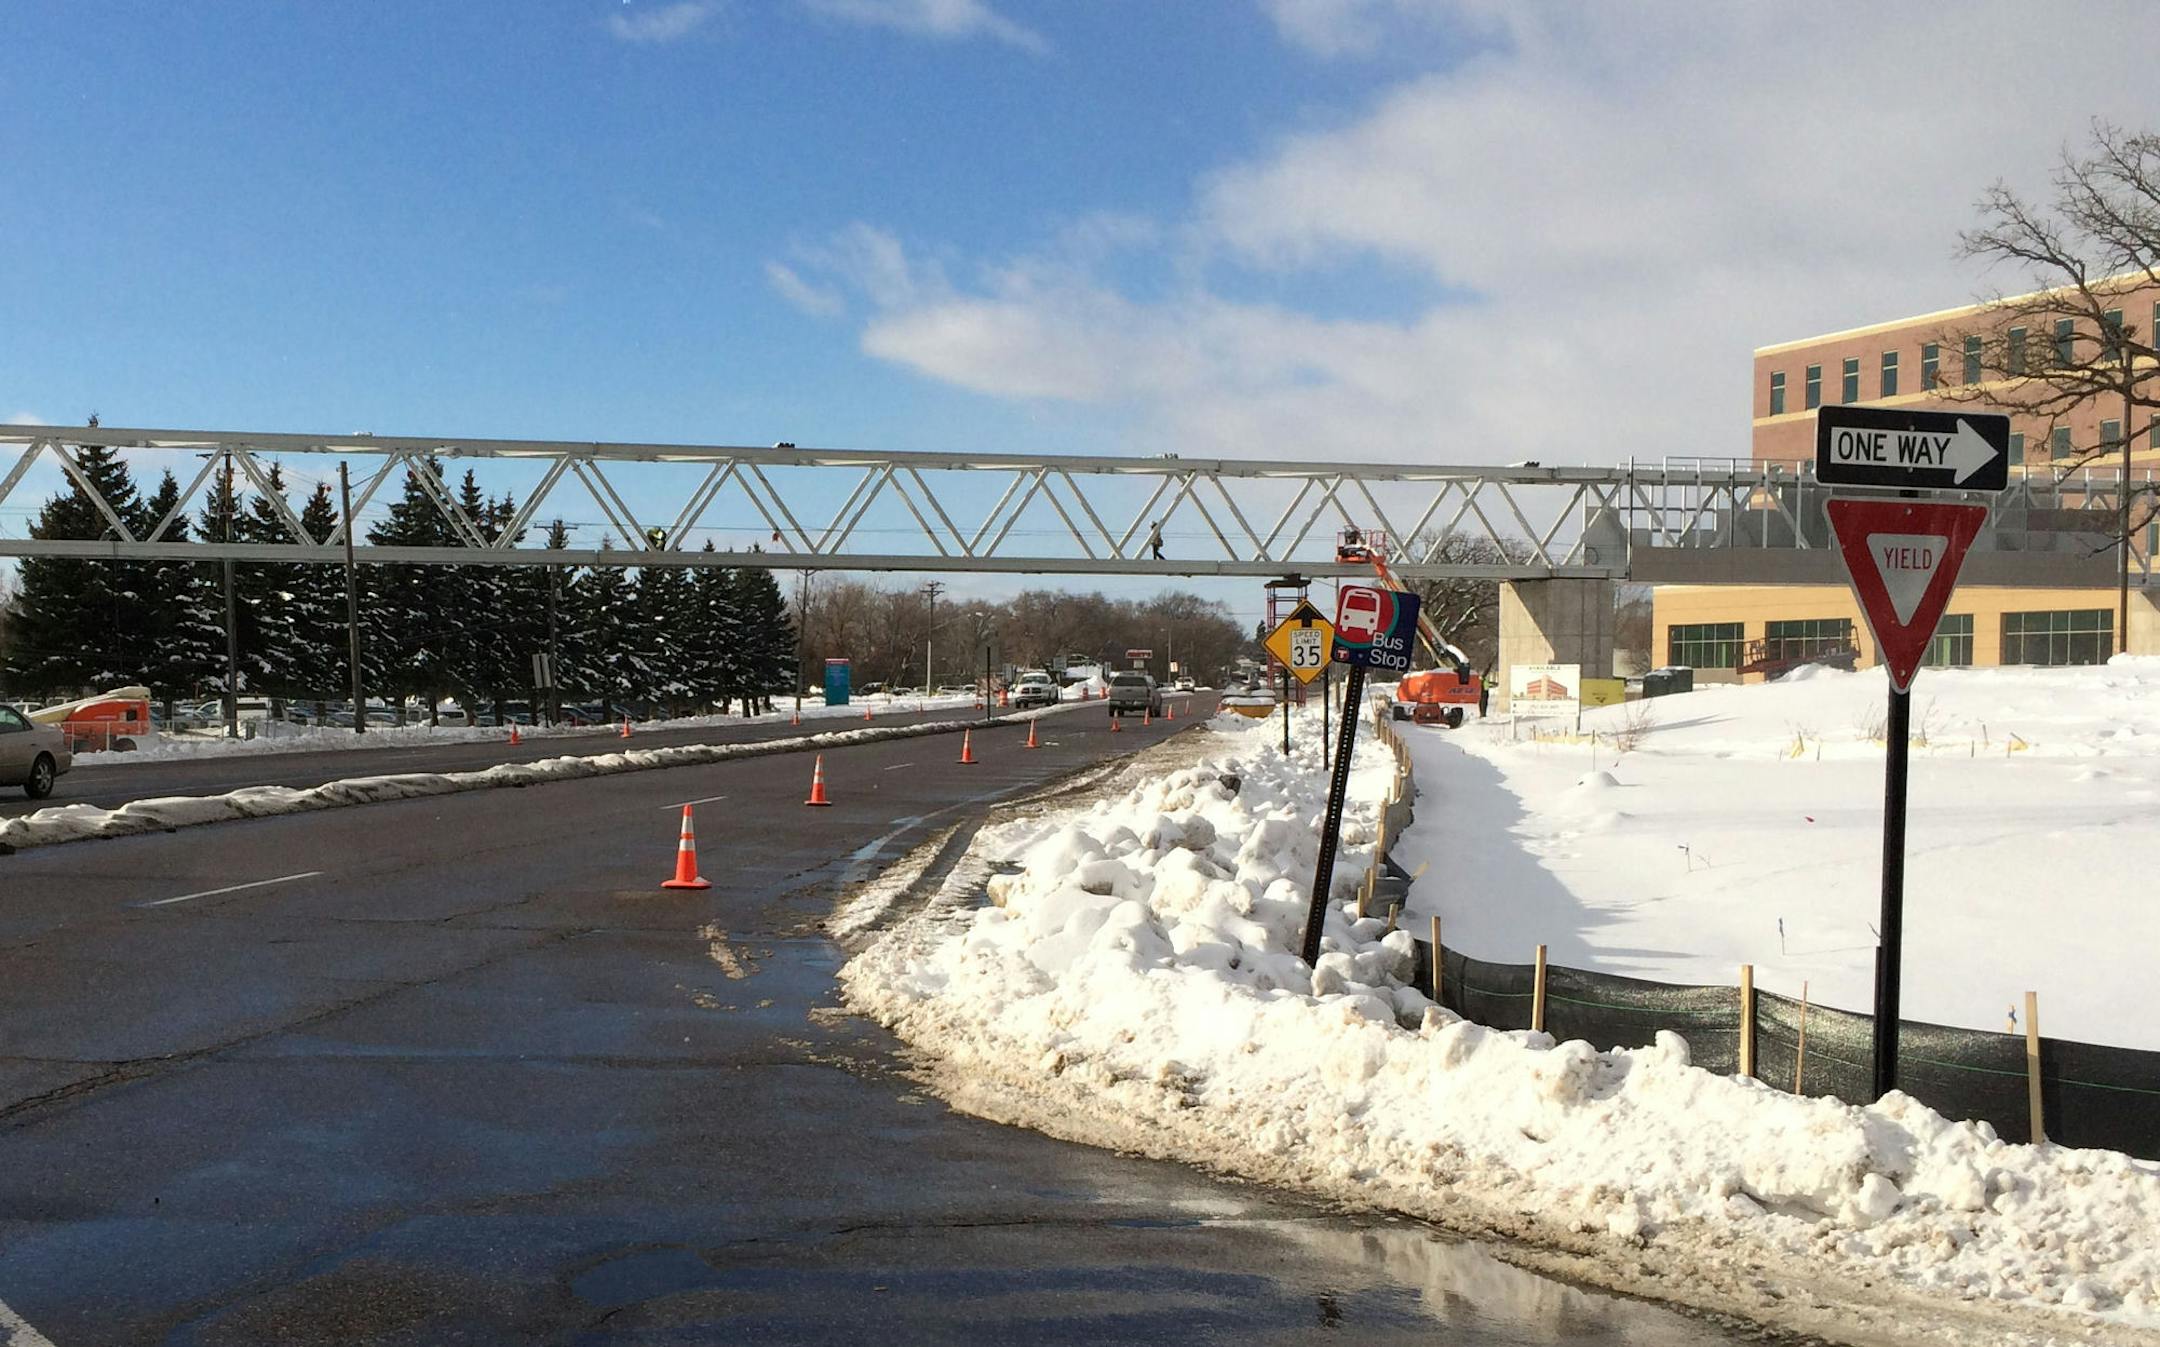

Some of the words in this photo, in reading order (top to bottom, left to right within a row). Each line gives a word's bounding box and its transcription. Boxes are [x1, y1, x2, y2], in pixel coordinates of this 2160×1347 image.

[1838, 430, 1887, 462] ONE
[1898, 435, 1951, 465] WAY
[1884, 547, 1932, 570] YIELD
[1372, 632, 1404, 650] Bus
[1293, 645, 1320, 666] 35
[1369, 649, 1408, 670] Stop
